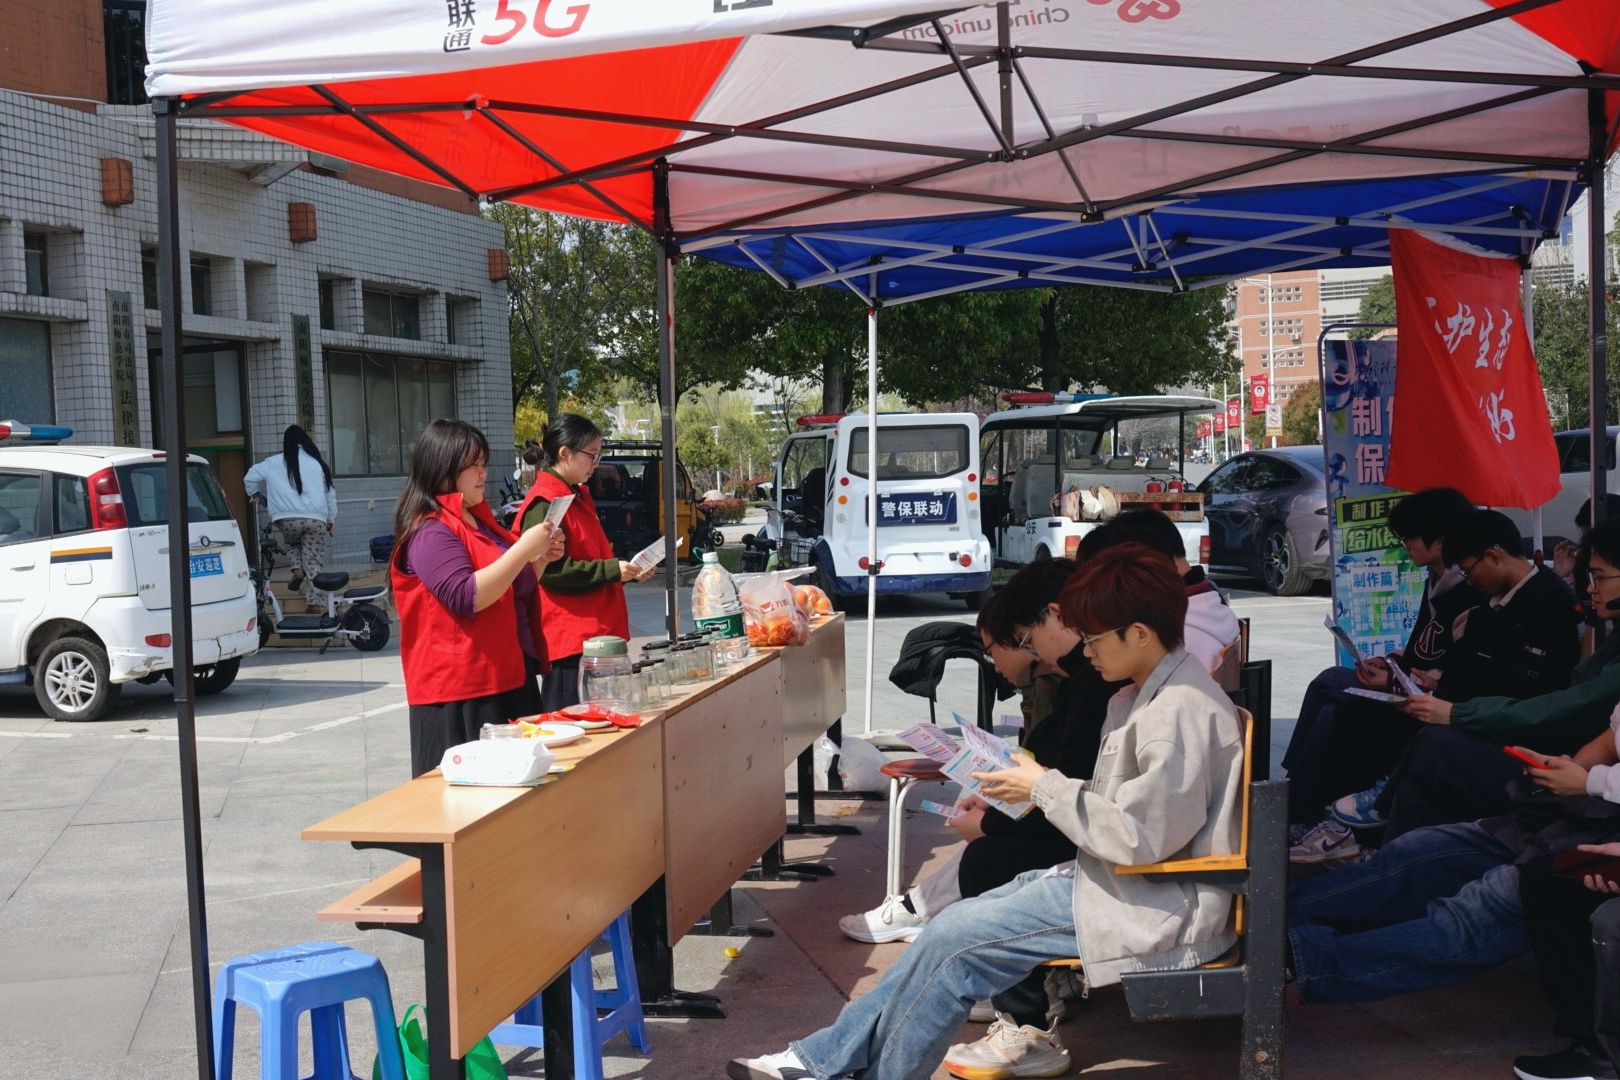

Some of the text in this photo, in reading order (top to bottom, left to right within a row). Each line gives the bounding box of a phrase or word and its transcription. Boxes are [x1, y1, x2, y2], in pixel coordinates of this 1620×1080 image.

[480, 0, 591, 46] 5G
[881, 500, 943, 518] 警保联动
[1026, 521, 1037, 535] 公安
